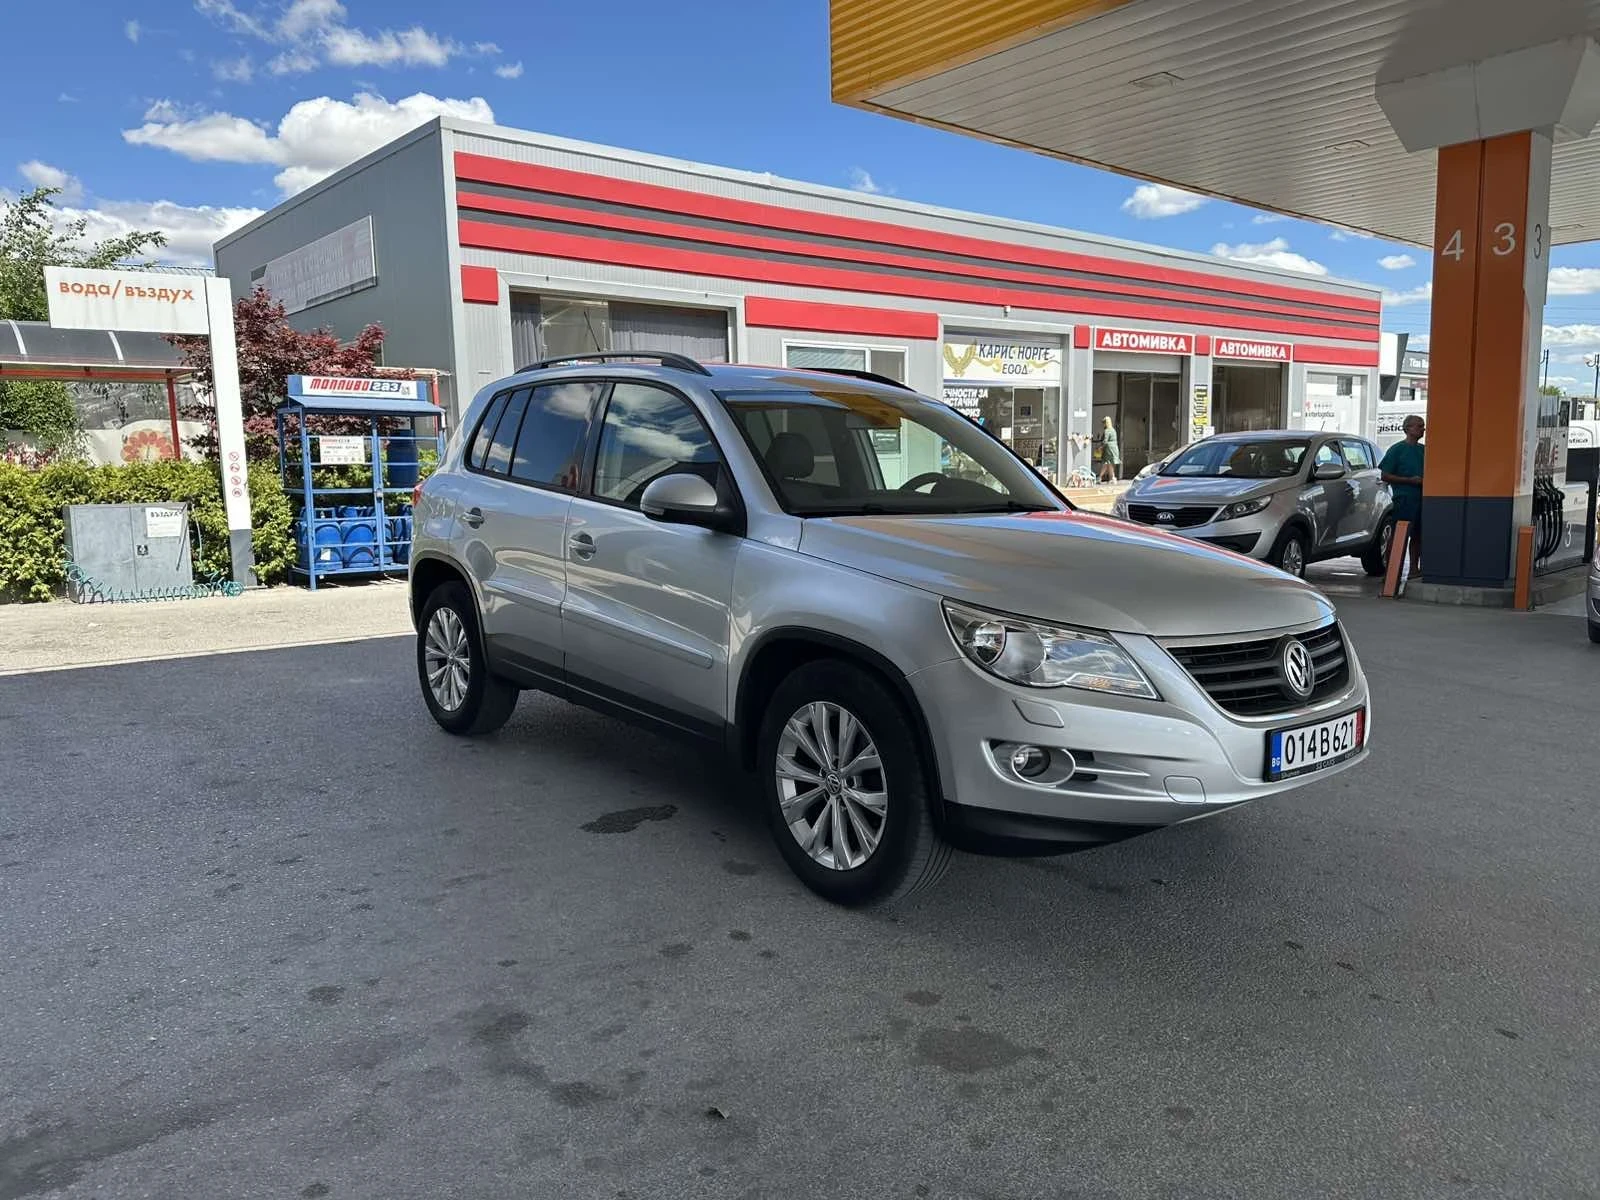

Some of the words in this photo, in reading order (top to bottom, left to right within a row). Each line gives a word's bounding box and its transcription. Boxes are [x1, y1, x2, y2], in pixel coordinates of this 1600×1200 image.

[1441, 229, 1464, 261] 4
[1492, 222, 1516, 256] 3
[1533, 223, 1541, 259] 3
[1102, 332, 1186, 351] АВТОМИВКА
[1219, 342, 1286, 358] АВТОМИВКА
[979, 343, 1015, 359] КАРИС
[1018, 346, 1050, 360] НОРГЕ
[1002, 363, 1028, 374] ЕООД
[978, 388, 988, 398] ЗА
[1565, 521, 1572, 547] 3
